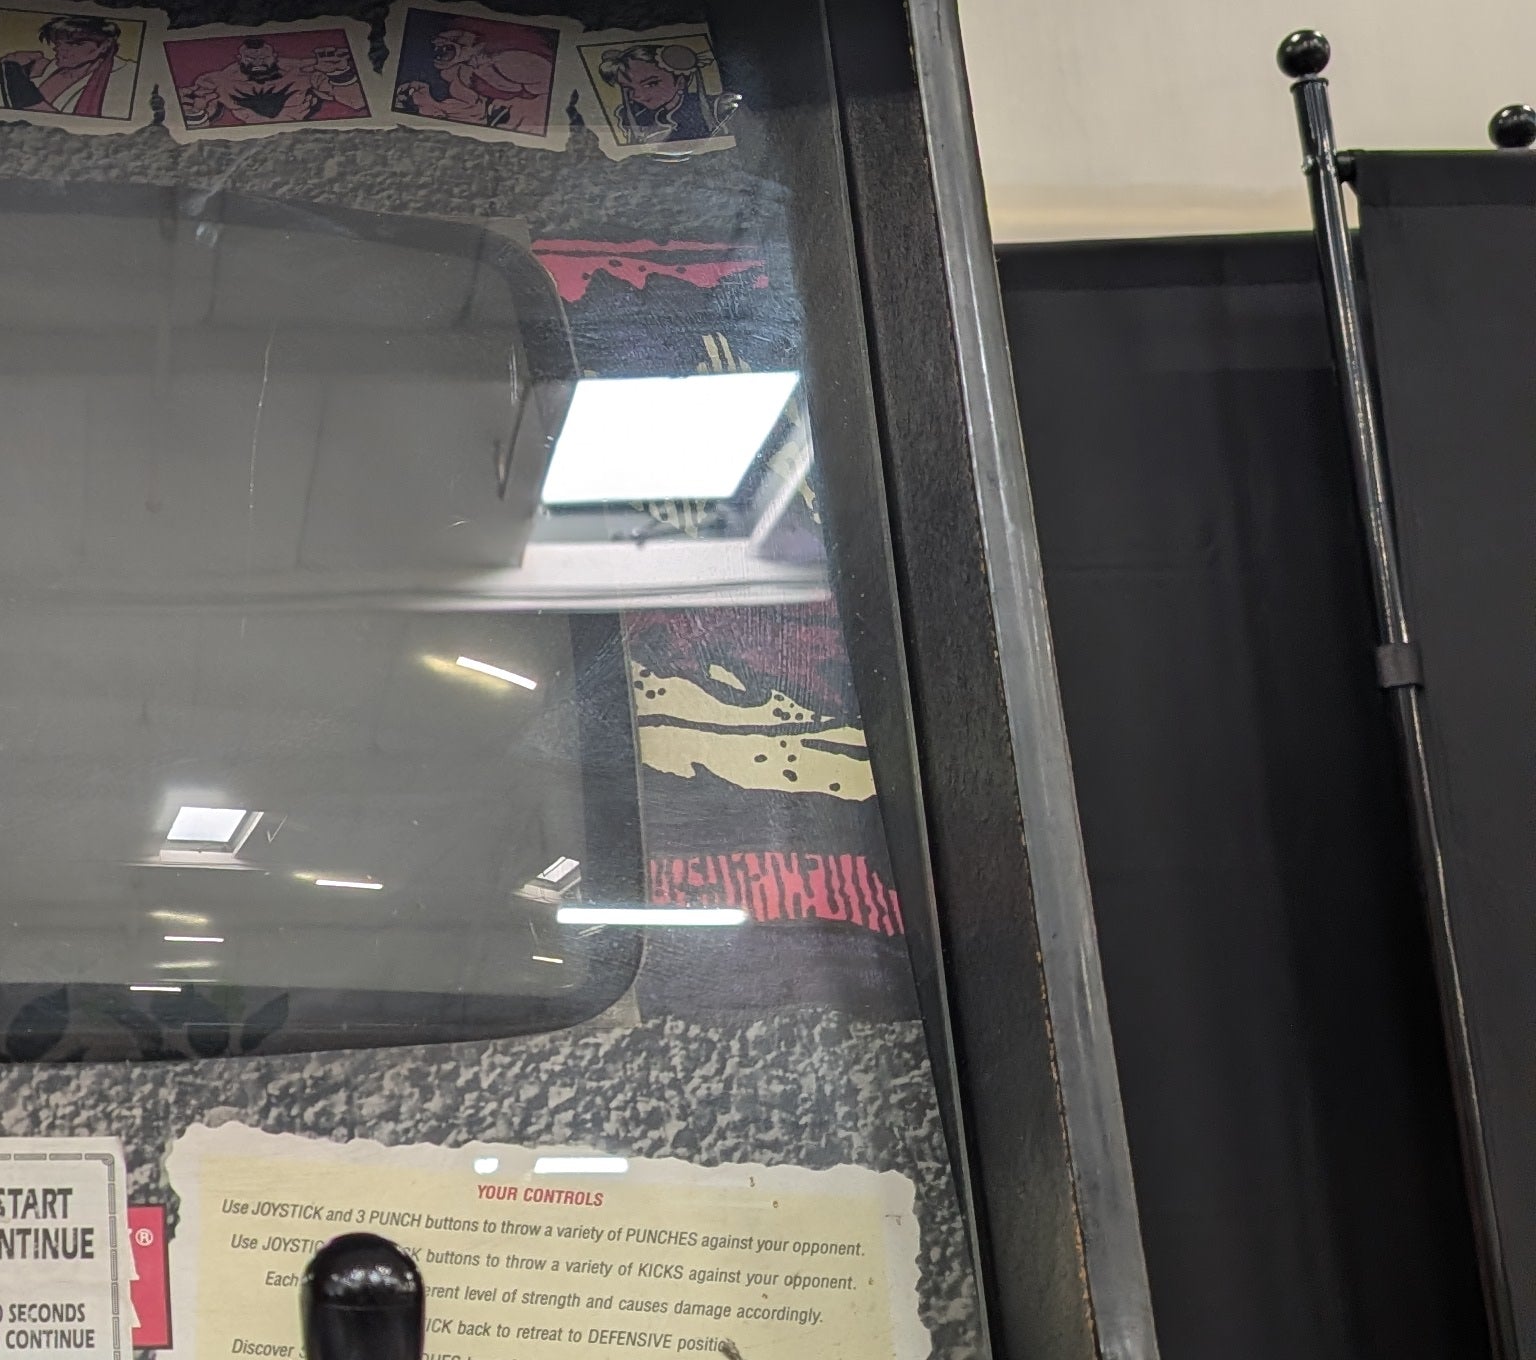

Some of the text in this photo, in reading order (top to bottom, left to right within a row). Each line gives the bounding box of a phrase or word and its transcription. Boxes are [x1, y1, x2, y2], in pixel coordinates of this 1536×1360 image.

[477, 1184, 605, 1207] YOUR CONTROLS
[222, 1198, 866, 1257] Use JOYSTICK and 3 PUNCH buttons to throw a variety of PUNCHES against your opponent.
[230, 1234, 258, 1250] Use
[262, 1235, 324, 1254] JOYSTIC
[425, 1248, 481, 1267] buttons
[485, 1253, 500, 1268] to
[505, 1254, 546, 1271] throw
[551, 1259, 560, 1272] a
[565, 1258, 614, 1278] variety
[617, 1262, 634, 1277] of
[637, 1263, 684, 1280] KICKS
[688, 1268, 741, 1285] against
[745, 1272, 780, 1287] your
[784, 1274, 857, 1291] opponent.
[265, 1270, 298, 1288] Each
[464, 1285, 498, 1302] level
[501, 1288, 518, 1303] of
[521, 1292, 581, 1311] strength
[586, 1295, 614, 1310] and
[618, 1298, 668, 1314] causes
[674, 1300, 732, 1319] damage
[736, 1305, 824, 1325] accordingly.
[8, 1303, 86, 1324] SECONDS
[6, 1329, 96, 1350] CONTINUE
[457, 1320, 492, 1337] back
[496, 1323, 511, 1338] to
[516, 1325, 563, 1342] retreat
[568, 1327, 582, 1343] to
[588, 1328, 673, 1349] DEFENSIVE
[231, 1338, 295, 1359] Discover
